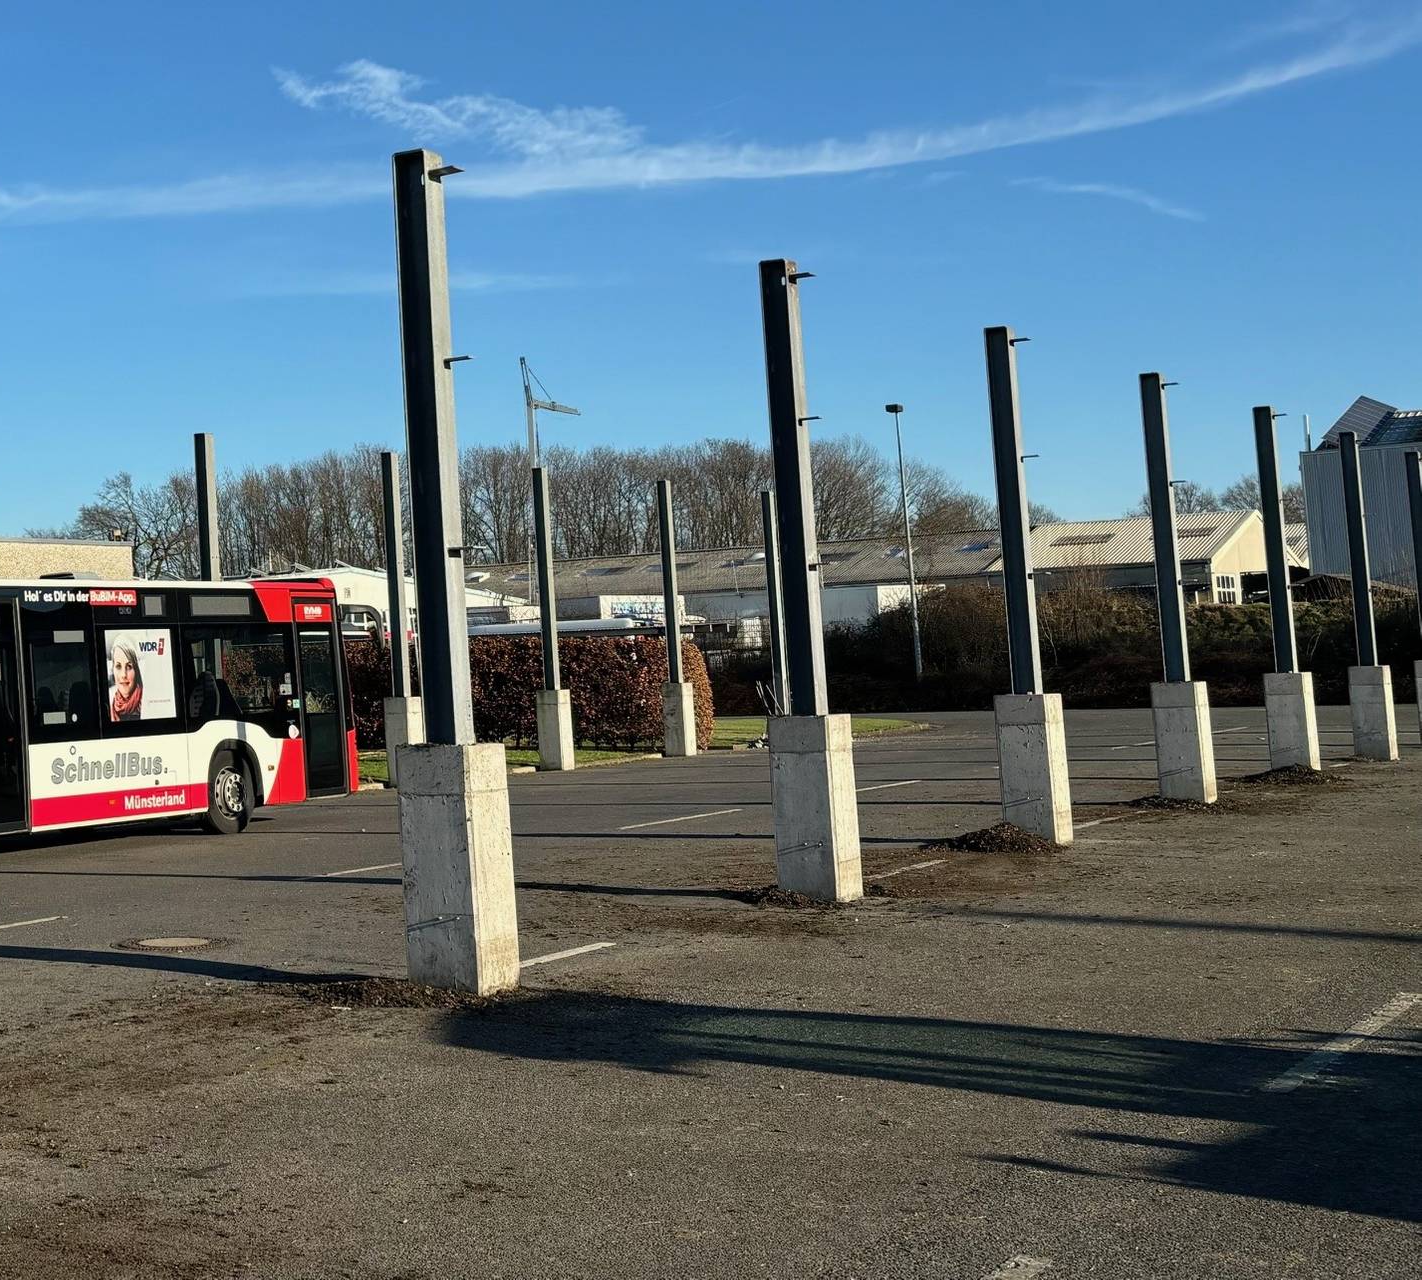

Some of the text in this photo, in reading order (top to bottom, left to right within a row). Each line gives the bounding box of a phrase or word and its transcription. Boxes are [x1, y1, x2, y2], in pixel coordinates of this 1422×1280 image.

[43, 593, 53, 602] es
[53, 590, 67, 602] Dir
[67, 591, 76, 602] in
[76, 590, 89, 602] der
[139, 641, 158, 652] WDR
[51, 751, 168, 785] SchnellBus.
[124, 789, 186, 810] Münsterland
